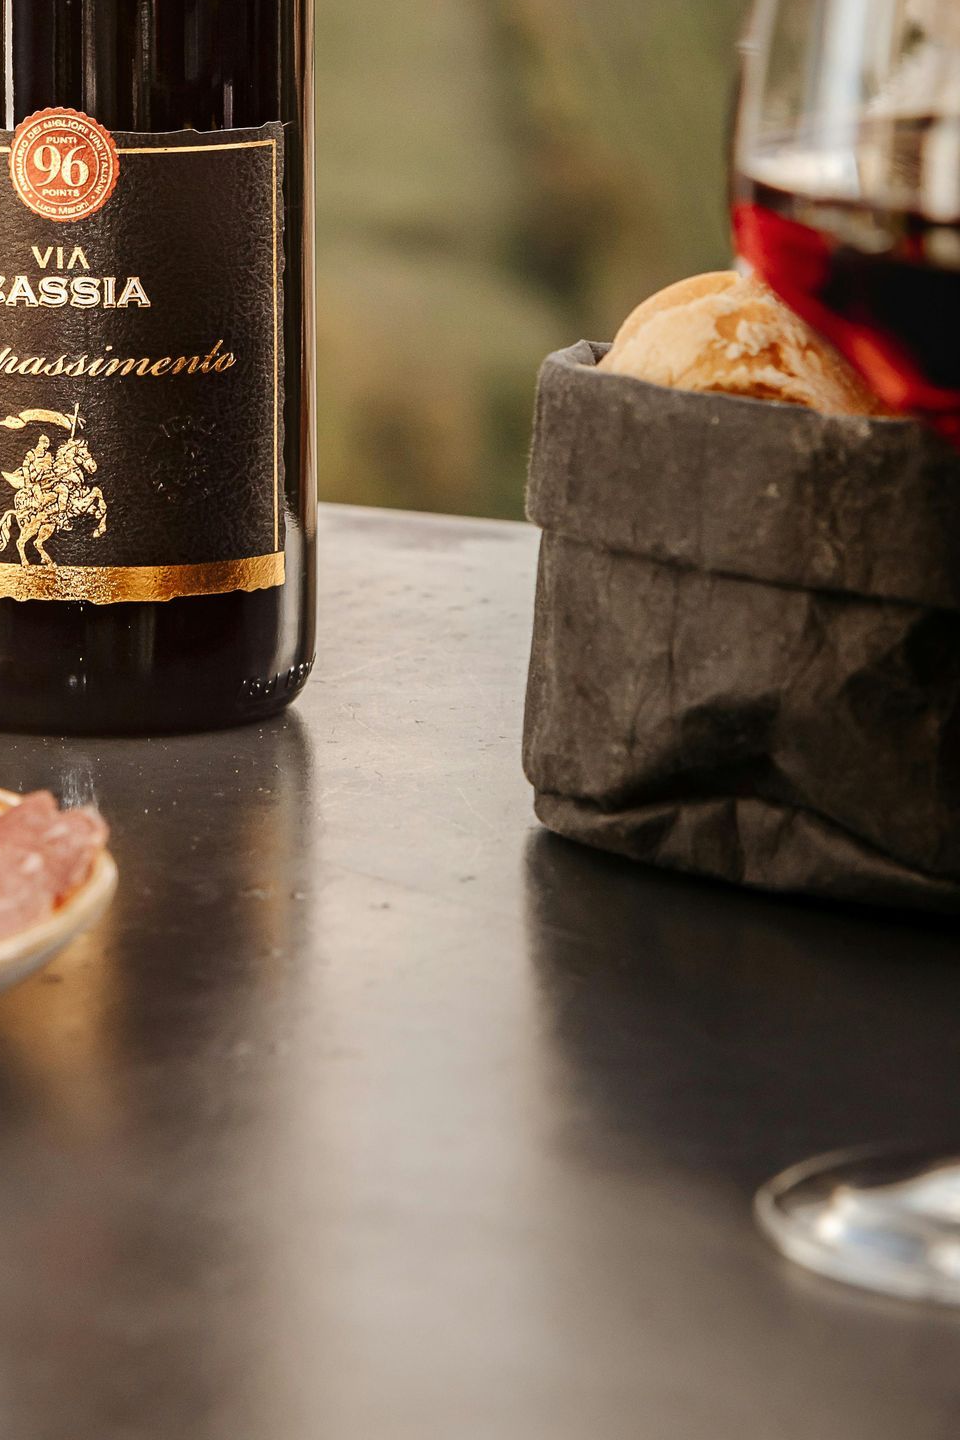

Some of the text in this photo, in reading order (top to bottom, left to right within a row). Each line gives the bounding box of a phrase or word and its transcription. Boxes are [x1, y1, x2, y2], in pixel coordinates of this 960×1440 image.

[27, 126, 42, 140] DEI
[43, 119, 89, 134] MIGLIORI
[46, 136, 78, 144] PUNTI
[89, 131, 103, 151] VINI
[33, 144, 89, 187] 96
[94, 152, 108, 195] ITALIANI
[42, 188, 80, 197] POINTS
[35, 200, 90, 215] Luca Maroni
[31, 246, 90, 269] VIA
